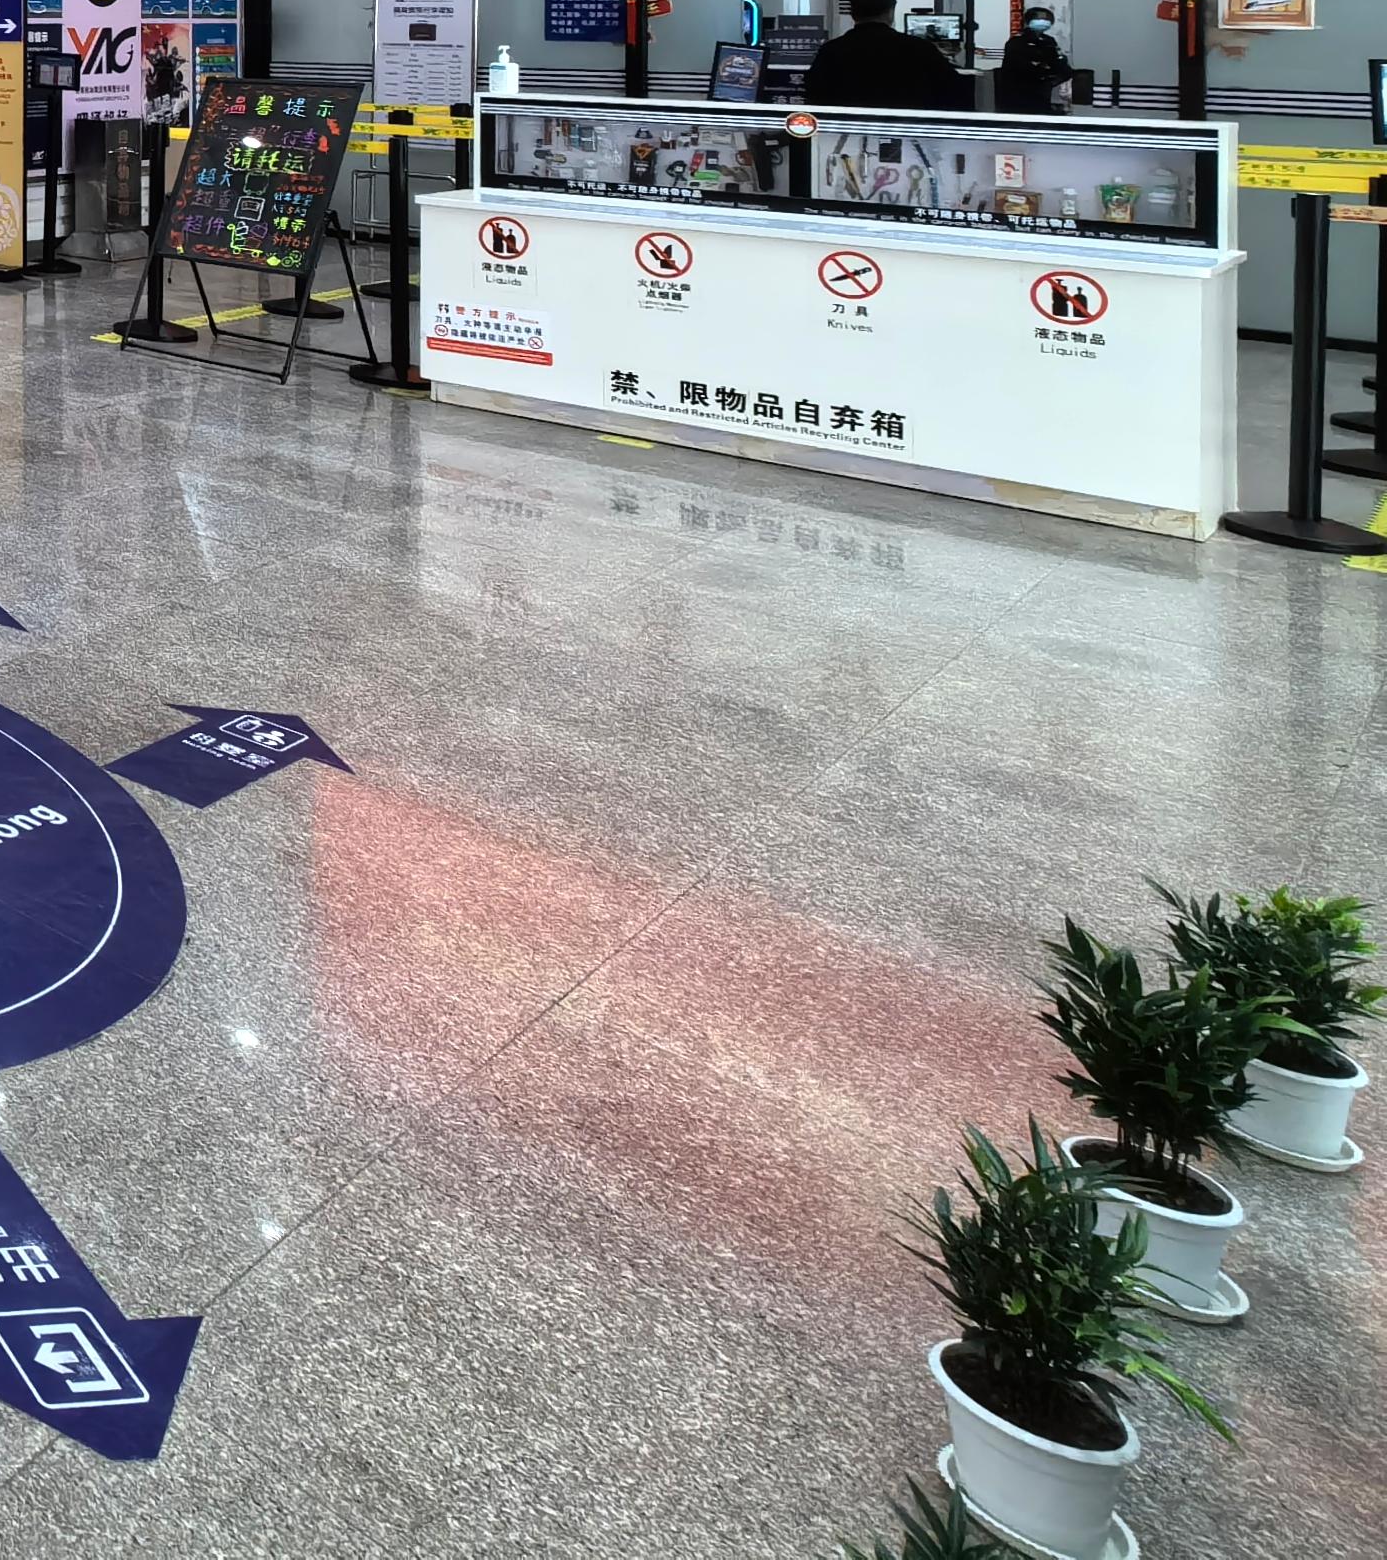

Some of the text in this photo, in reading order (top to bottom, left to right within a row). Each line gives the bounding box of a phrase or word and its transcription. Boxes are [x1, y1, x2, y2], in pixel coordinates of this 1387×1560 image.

[224, 95, 336, 118] 温馨提示
[233, 147, 306, 173] 请托运
[196, 167, 234, 188] 超大
[485, 275, 523, 287] Liquids
[831, 303, 870, 318] 刀具
[825, 318, 875, 334] Knives
[1034, 326, 1106, 347] 液态物品
[1039, 343, 1097, 359] Liquids
[610, 369, 906, 440] 禁、限物品自弃箱
[610, 395, 906, 451] Prohibited and Restricted Articles Recycling Center
